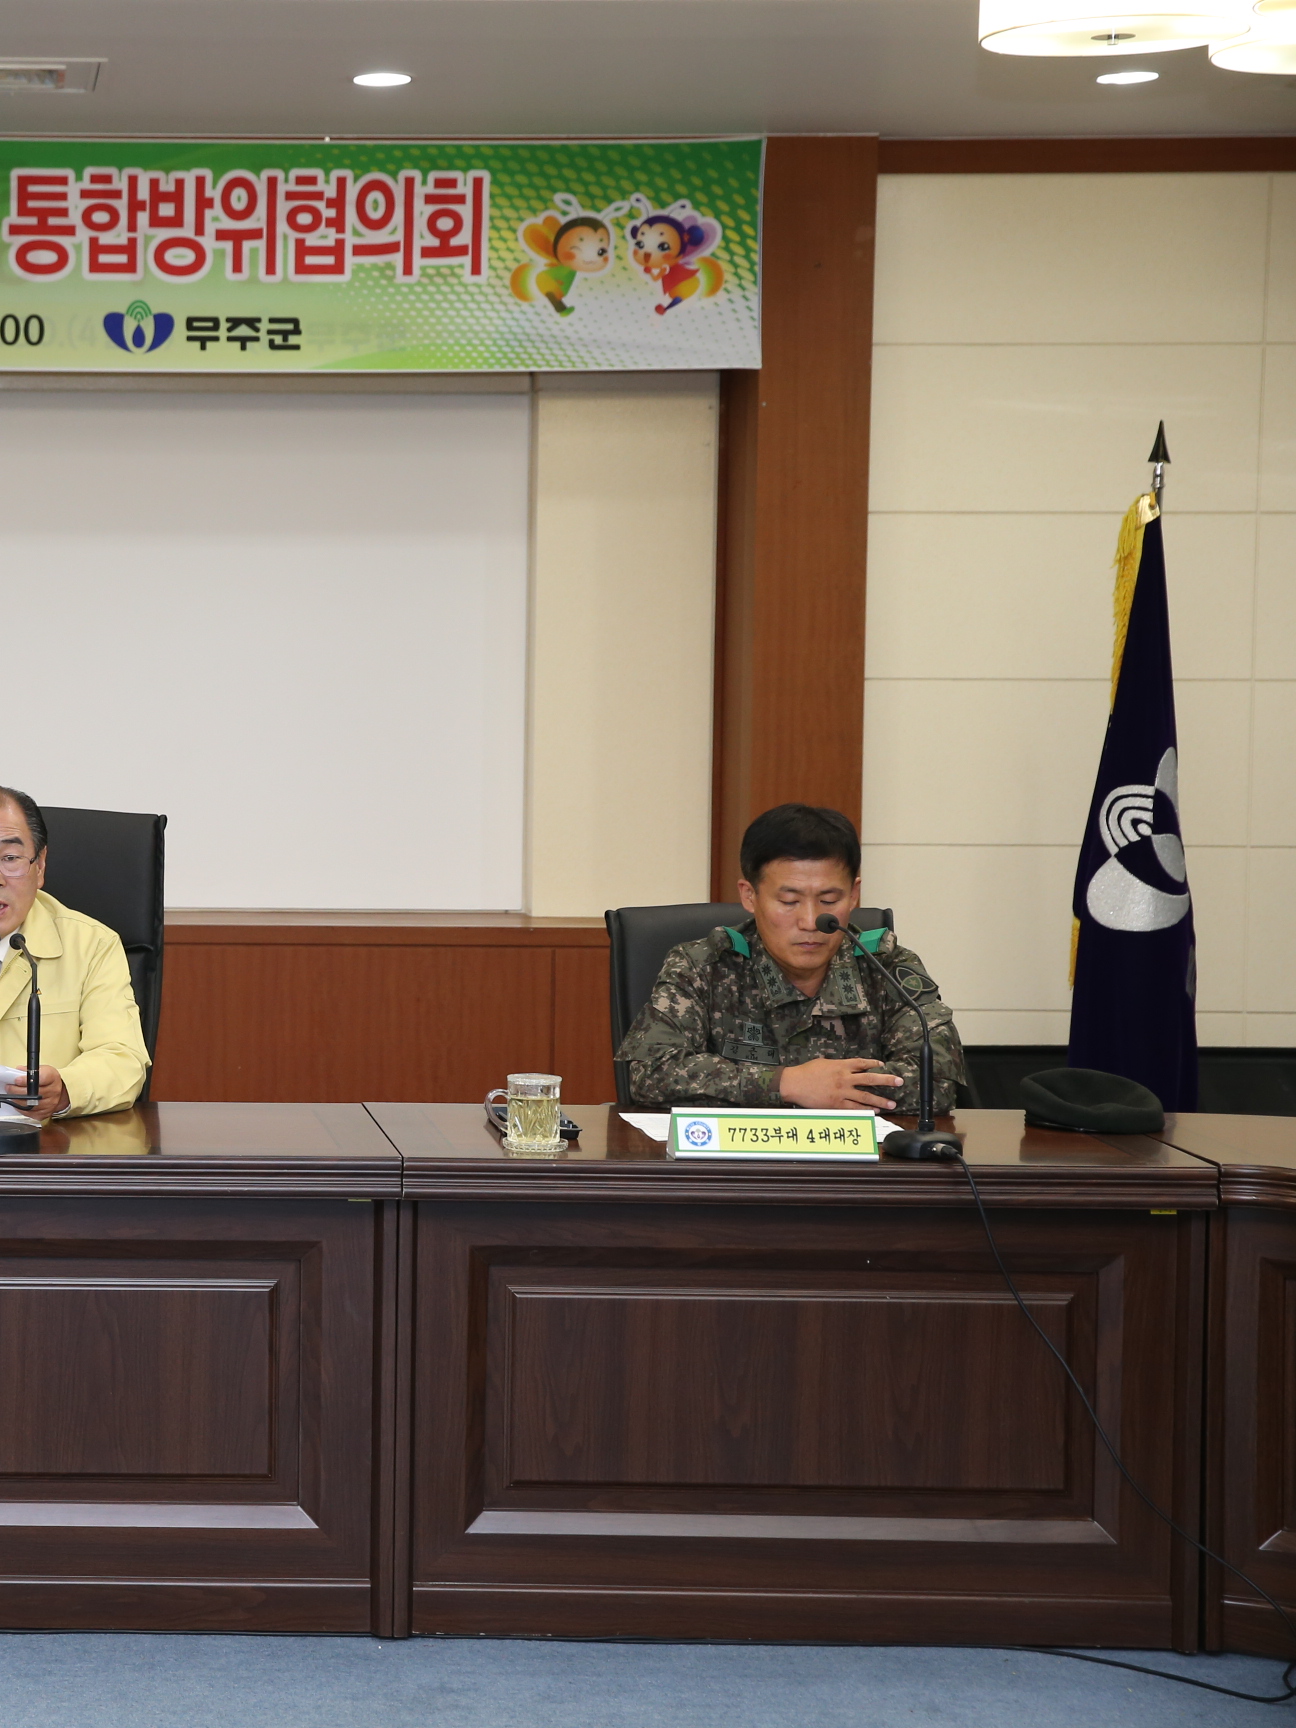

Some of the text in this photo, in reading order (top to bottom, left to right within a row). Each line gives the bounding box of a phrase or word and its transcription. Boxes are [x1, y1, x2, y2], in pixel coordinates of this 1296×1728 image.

[7, 173, 484, 278] 통합방위협의회
[184, 316, 302, 352] 무주군
[727, 1126, 799, 1145] 7733부대
